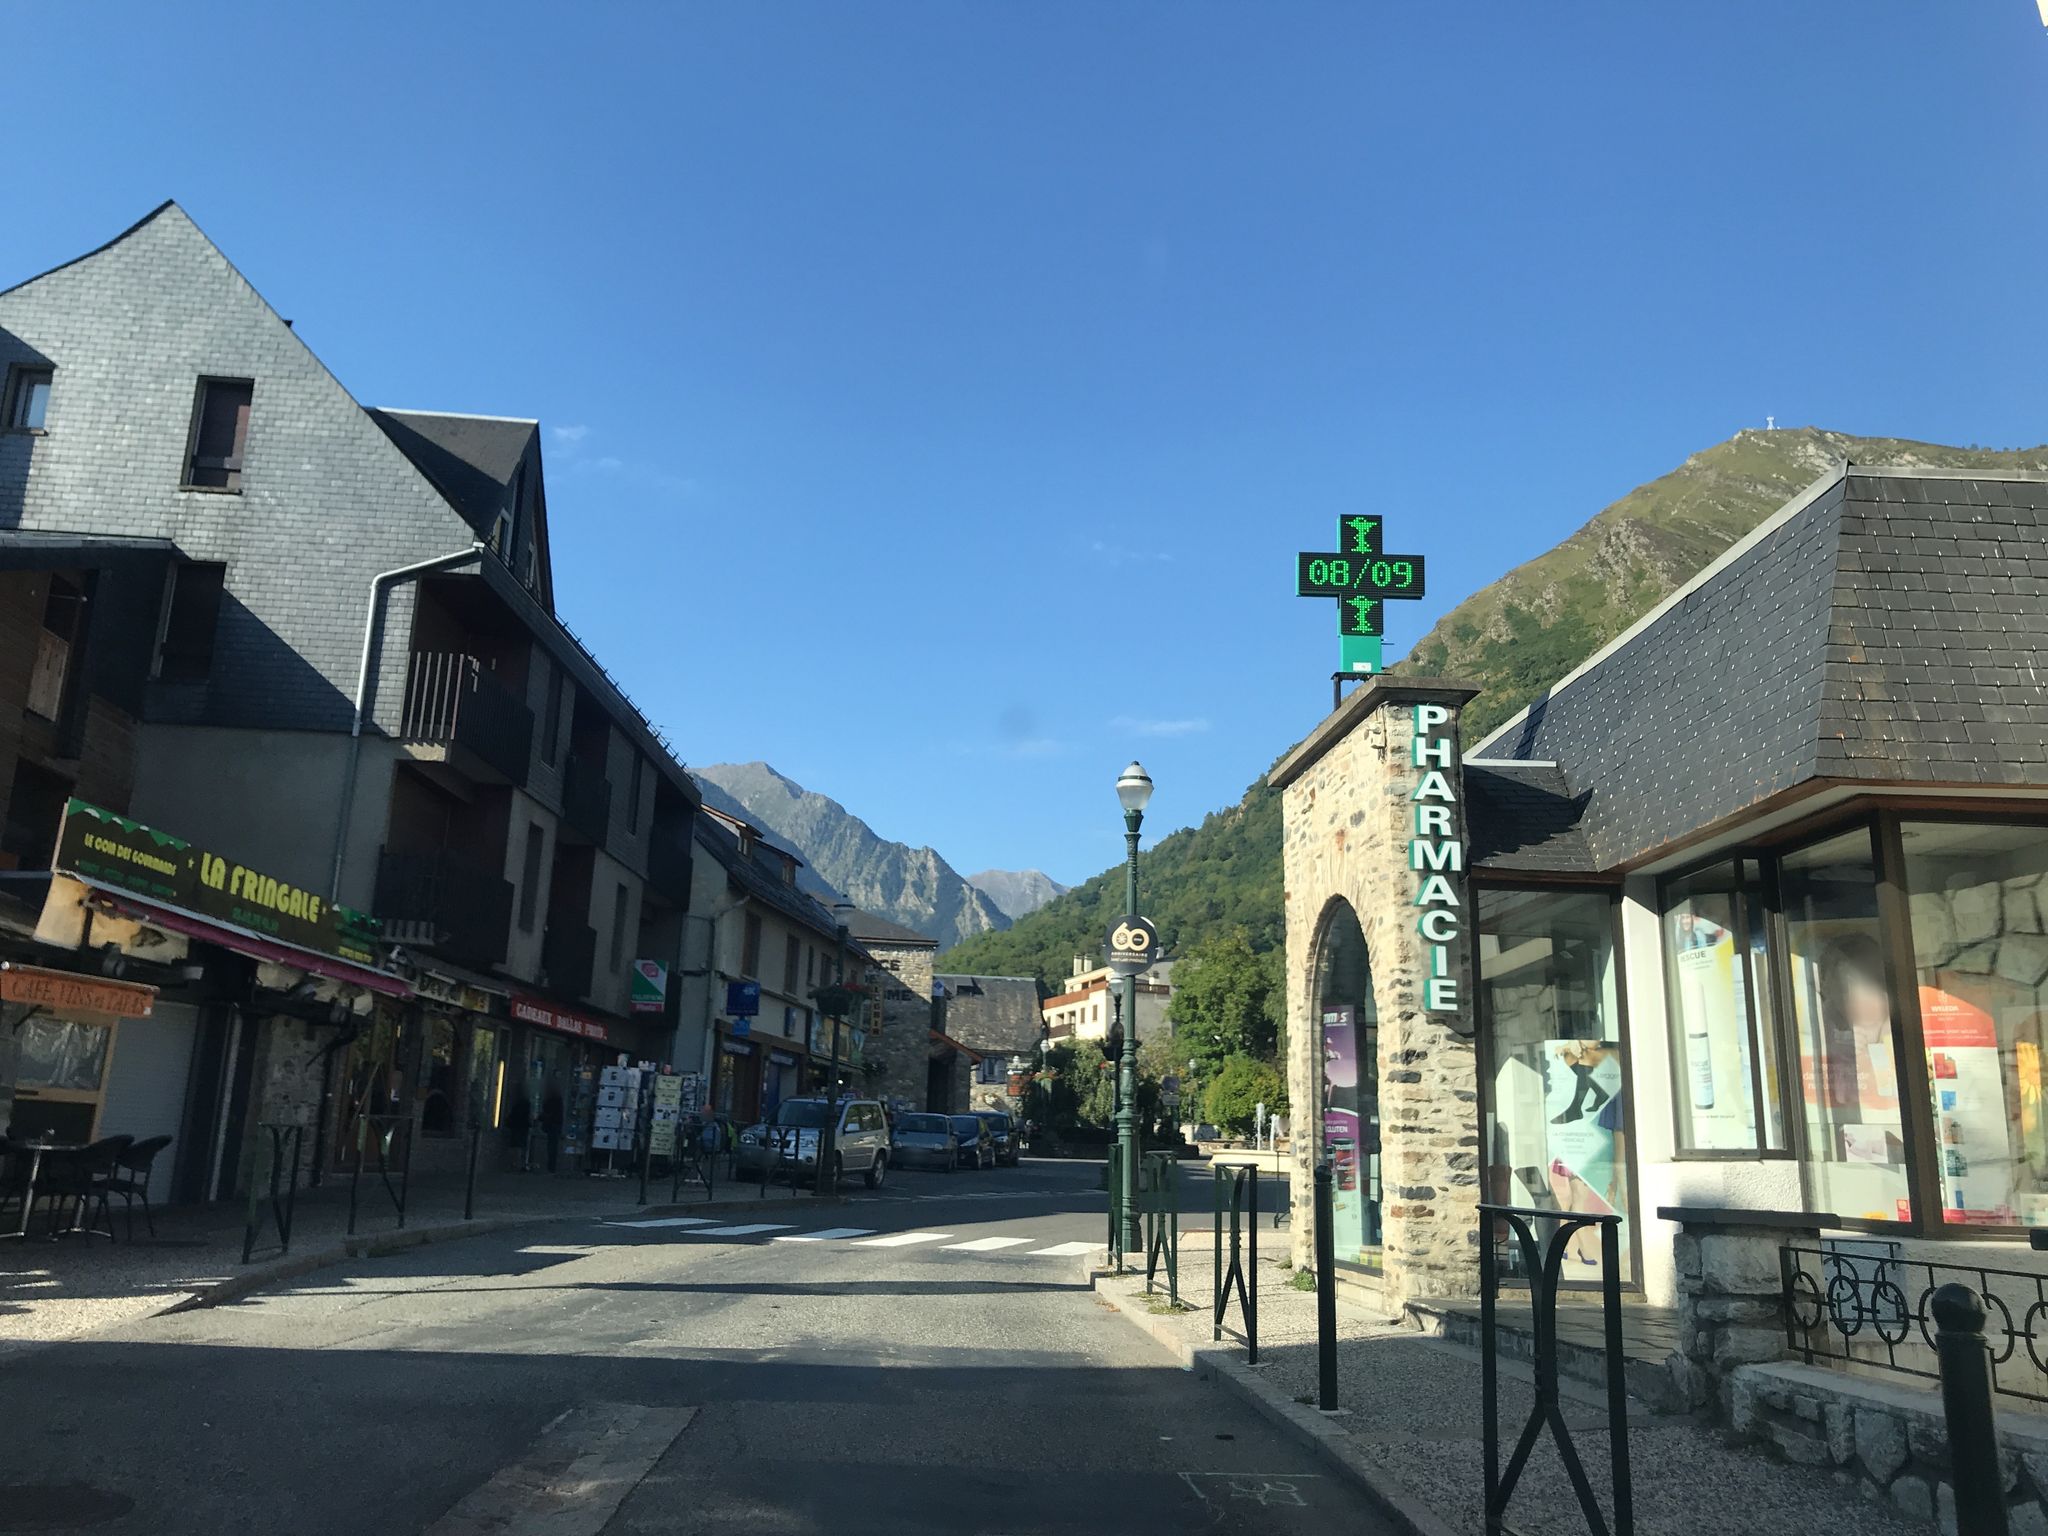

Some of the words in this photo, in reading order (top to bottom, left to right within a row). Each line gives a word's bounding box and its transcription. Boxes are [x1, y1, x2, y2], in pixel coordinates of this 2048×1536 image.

[1309, 559, 1413, 589] 08/09
[200, 851, 226, 891] LA
[229, 864, 321, 924] FRINGALE
[1408, 704, 1461, 1011] PHARMACIE
